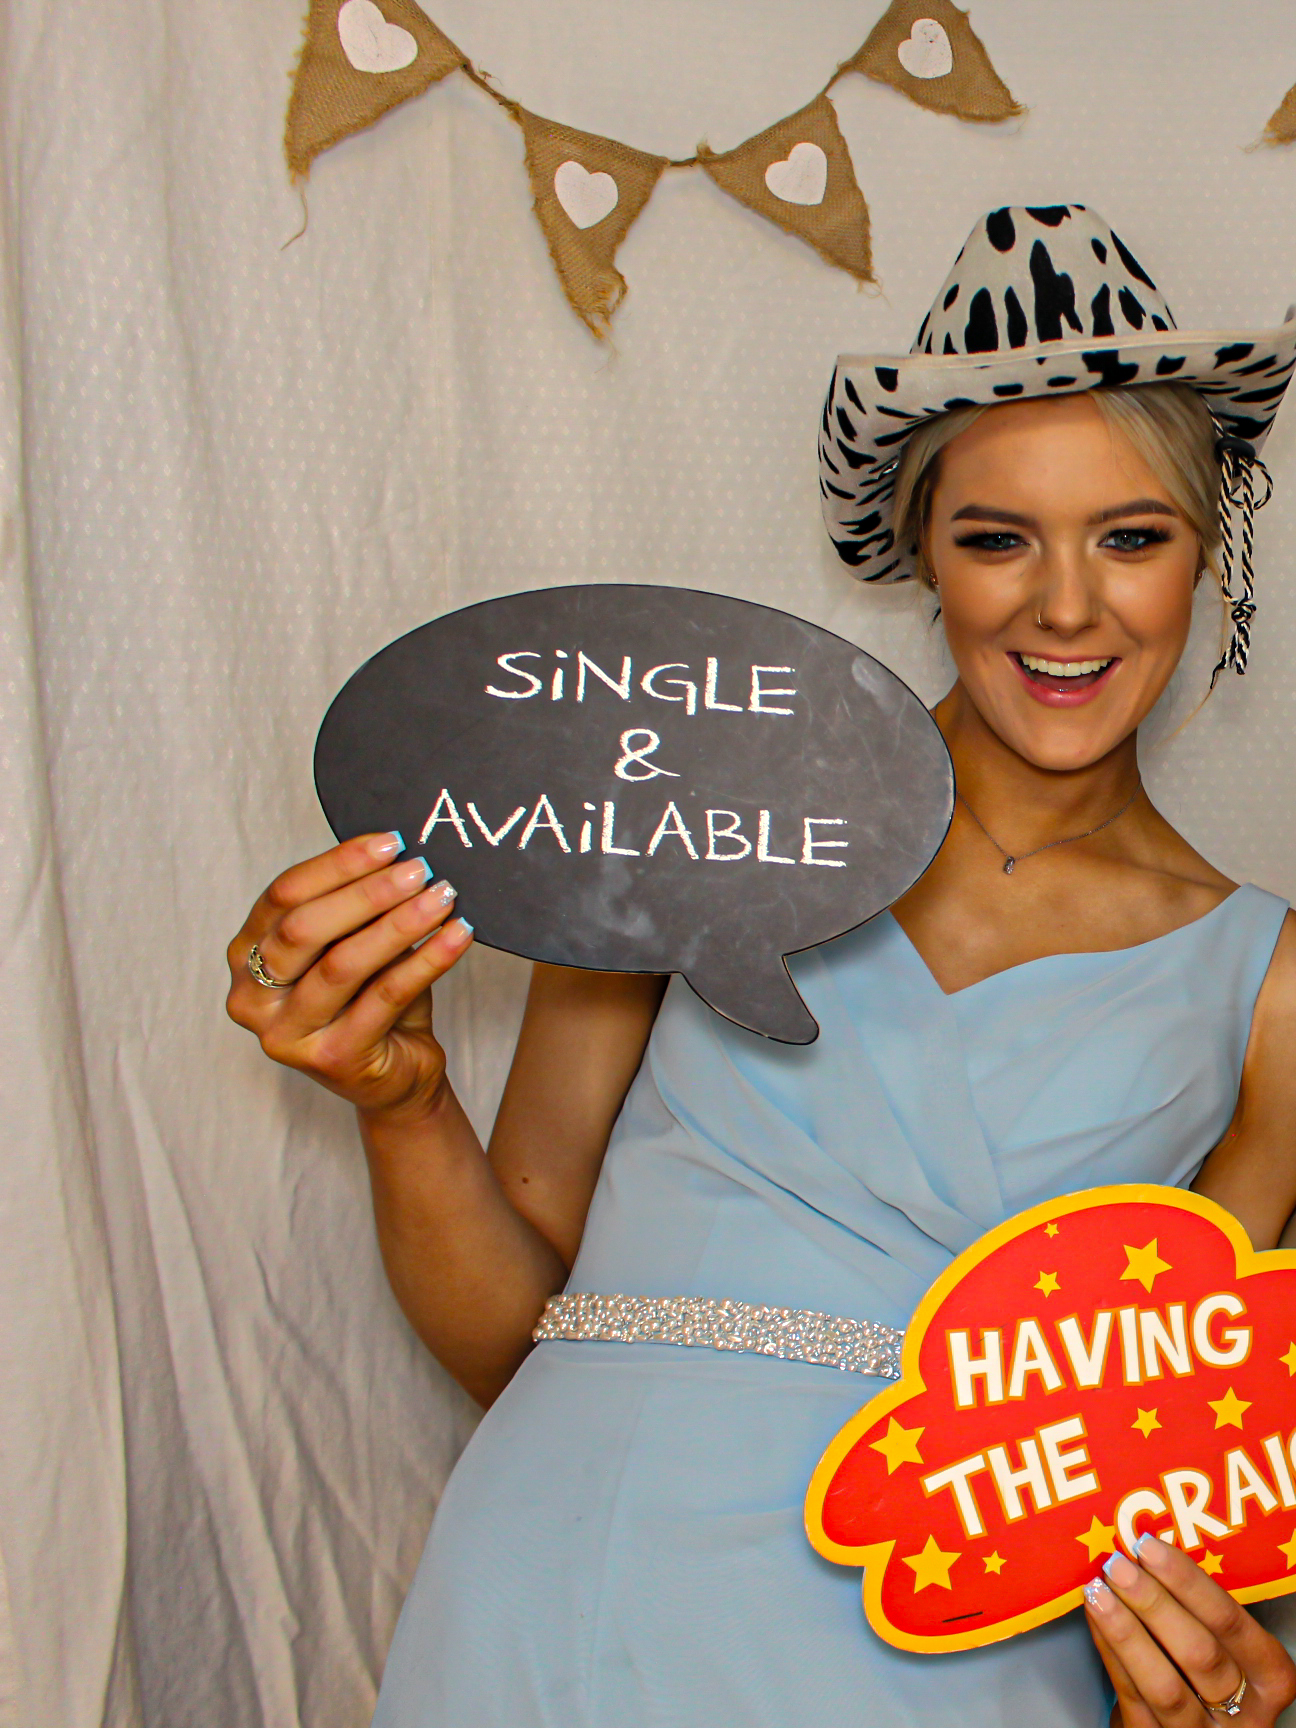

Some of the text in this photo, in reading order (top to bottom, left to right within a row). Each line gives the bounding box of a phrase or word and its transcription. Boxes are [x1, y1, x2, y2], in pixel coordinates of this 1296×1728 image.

[613, 727, 681, 782] &
[946, 1292, 1253, 1411] HAVING
[920, 1413, 1101, 1540] THE
